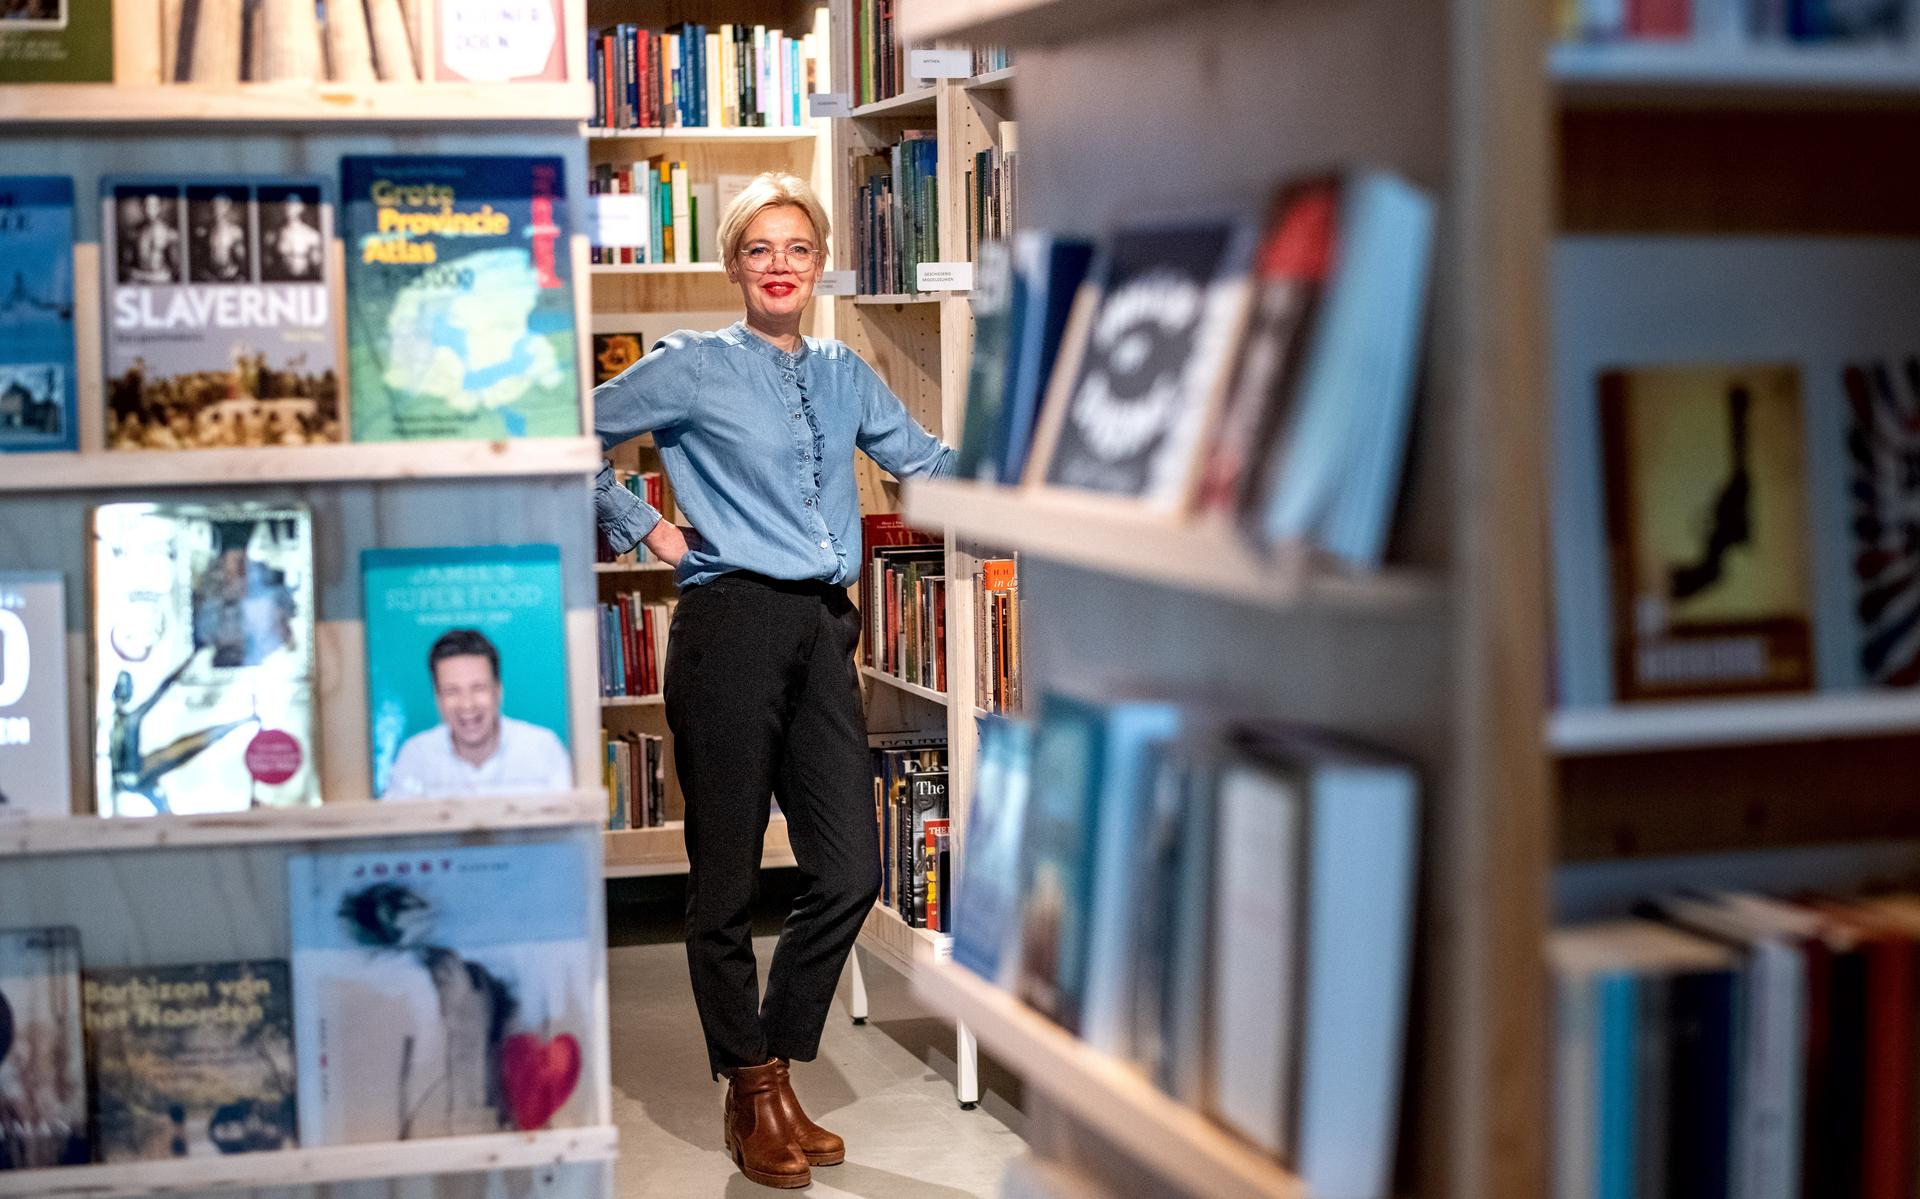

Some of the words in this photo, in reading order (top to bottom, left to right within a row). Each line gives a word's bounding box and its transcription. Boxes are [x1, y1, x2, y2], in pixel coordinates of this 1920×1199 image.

[371, 179, 454, 208] Grote
[377, 204, 509, 236] Provincie
[363, 238, 437, 264] Atlas
[114, 287, 328, 329] SLAVERNIJ
[993, 578, 1004, 588] in
[916, 780, 945, 796] The
[928, 826, 947, 836] THE
[84, 976, 210, 1003] Barbizon
[217, 978, 270, 998] van
[137, 1001, 263, 1027] Noorden
